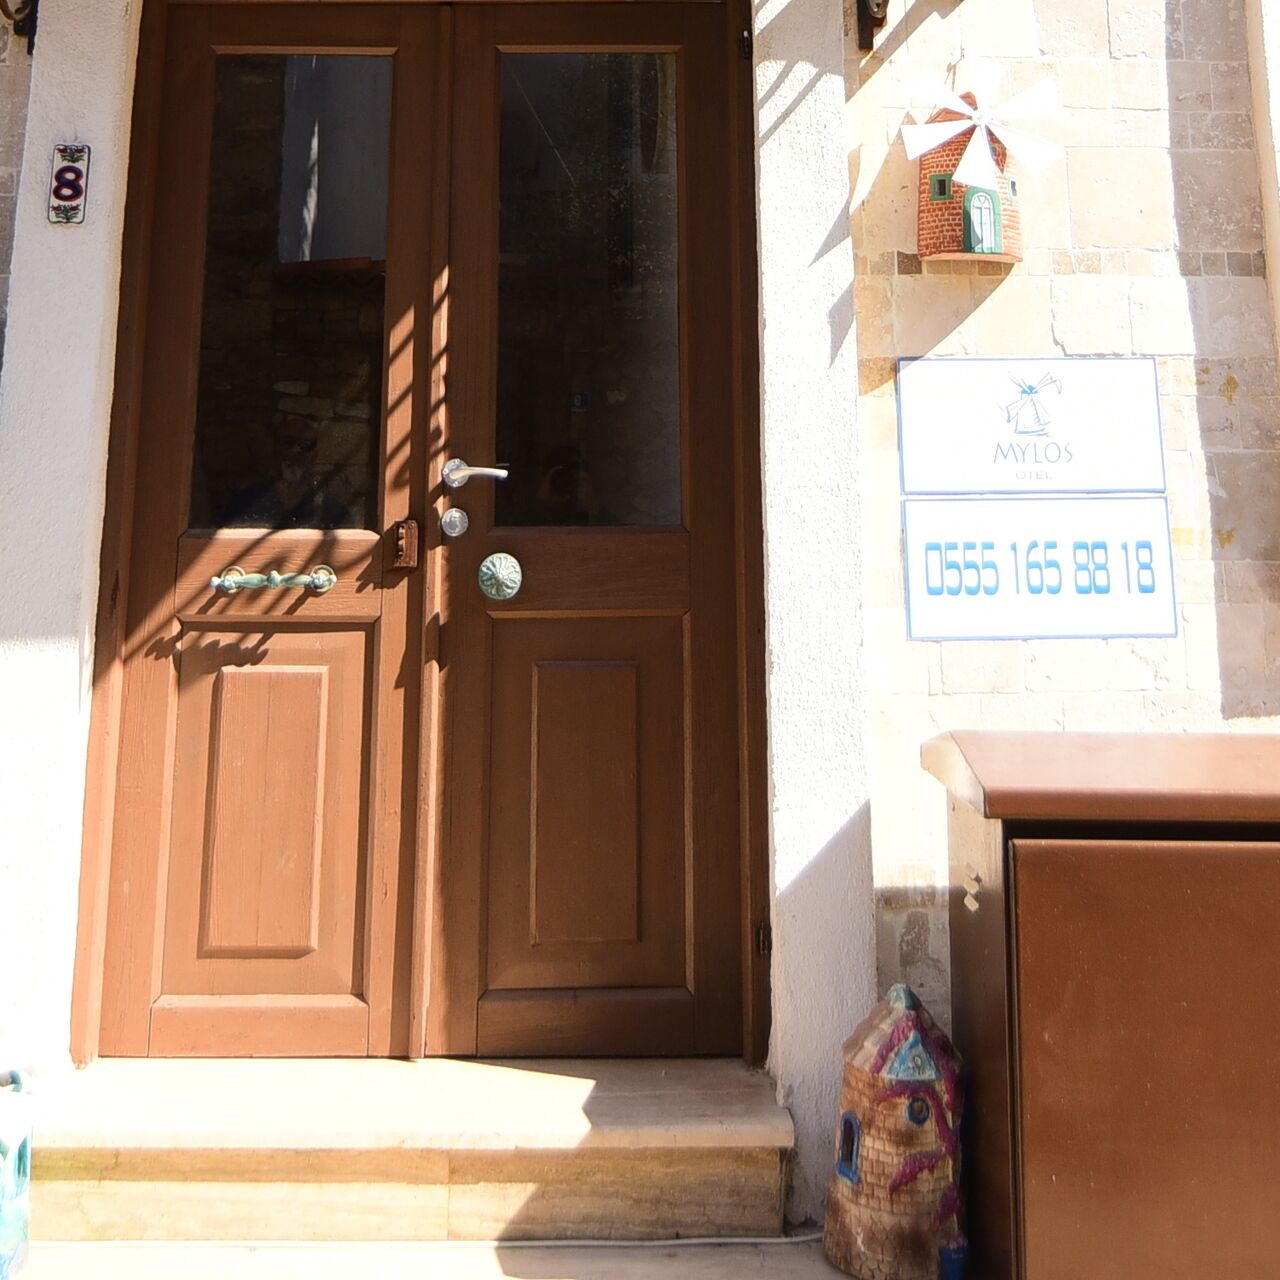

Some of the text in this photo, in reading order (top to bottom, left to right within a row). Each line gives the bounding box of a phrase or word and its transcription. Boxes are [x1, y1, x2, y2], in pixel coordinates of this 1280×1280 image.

[52, 165, 84, 202] 8
[993, 441, 1073, 464] MYLOS
[924, 539, 1156, 596] 0555 165 88 18
